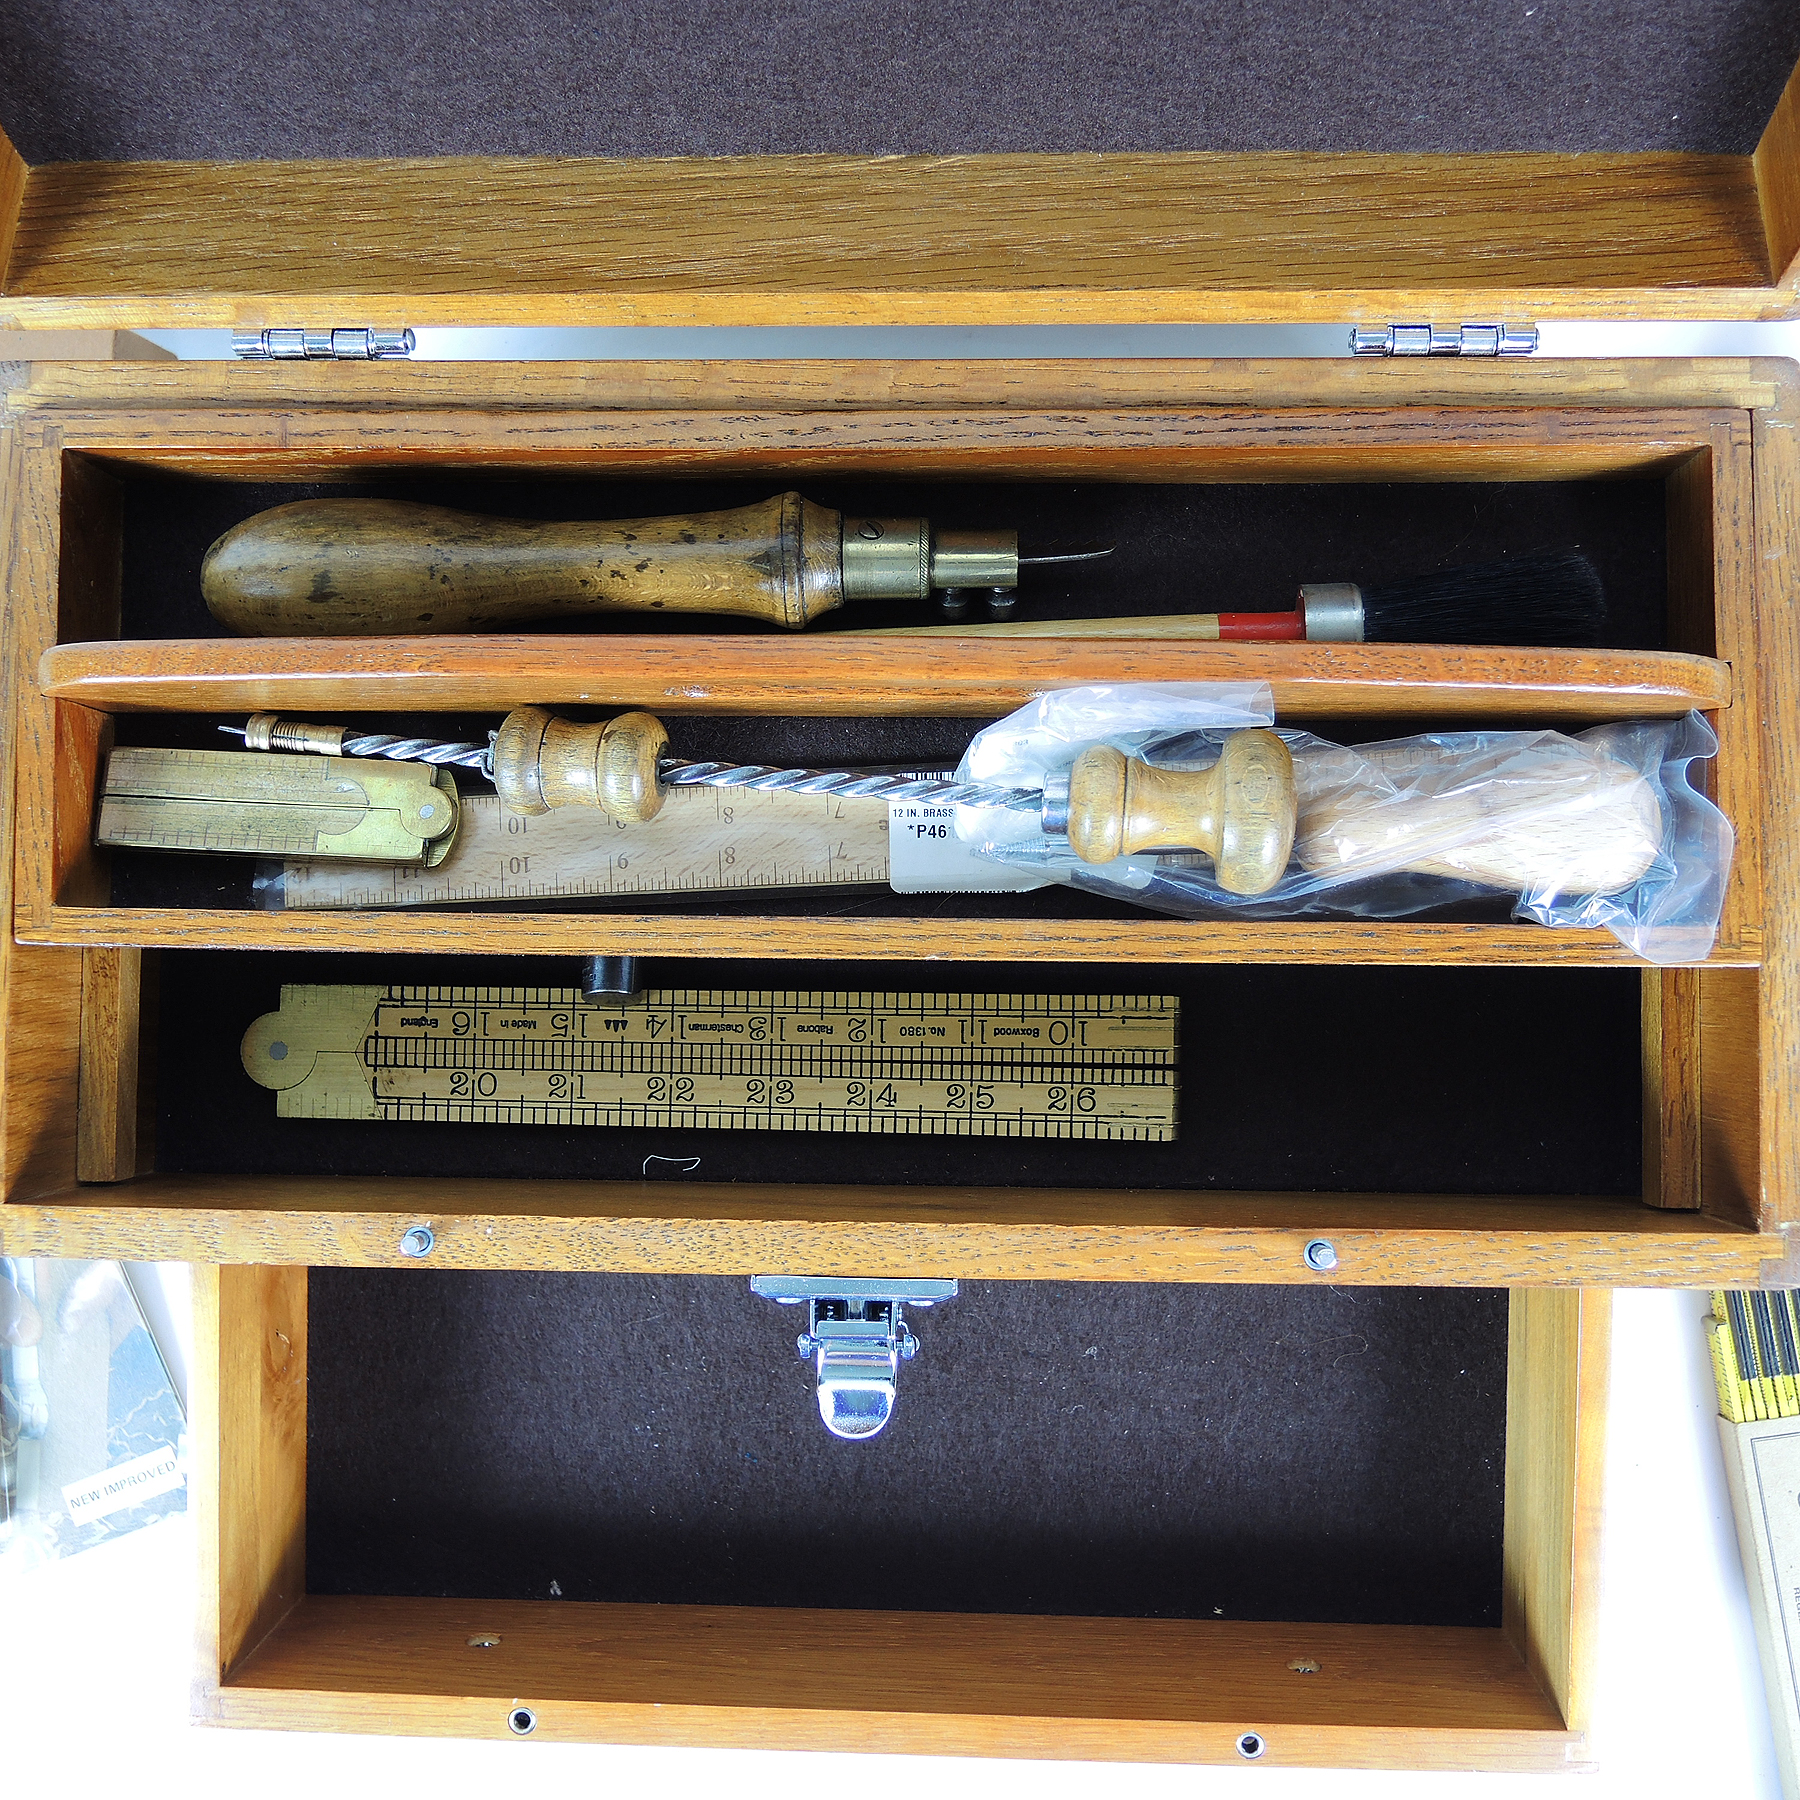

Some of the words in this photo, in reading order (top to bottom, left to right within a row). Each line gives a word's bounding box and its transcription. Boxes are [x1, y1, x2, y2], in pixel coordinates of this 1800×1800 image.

[722, 807, 735, 825] 8
[834, 801, 846, 819] 7
[893, 809, 903, 818] 12
[907, 809, 920, 818] IN.
[924, 809, 954, 818] BRASS
[508, 816, 529, 834] 10
[907, 824, 951, 839] P46
[723, 846, 736, 864] 8
[835, 841, 847, 859] 7
[510, 855, 531, 874] 10
[617, 852, 629, 870] 9
[400, 1016, 439, 1029] England
[451, 1010, 489, 1036] 16
[500, 1019, 511, 1028] in
[513, 1019, 537, 1029] Made
[550, 1013, 588, 1038] 15
[645, 1014, 686, 1039] 14
[688, 1021, 744, 1034] Chesterman
[748, 1016, 787, 1041] 13
[796, 1023, 834, 1035] Rabone
[848, 1017, 887, 1043] 12
[960, 1019, 987, 1045] 11
[993, 1026, 1040, 1038] Boxwood
[1049, 1020, 1088, 1046] 10
[450, 1071, 498, 1097] 20
[548, 1074, 586, 1100] 21
[646, 1077, 695, 1102] 22
[746, 1079, 795, 1104] 23
[847, 1081, 898, 1107] 24
[947, 1084, 996, 1109] 25
[1047, 1087, 1096, 1112] 26
[70, 1490, 101, 1509] NEW
[103, 1460, 176, 1496] IMPROVED
